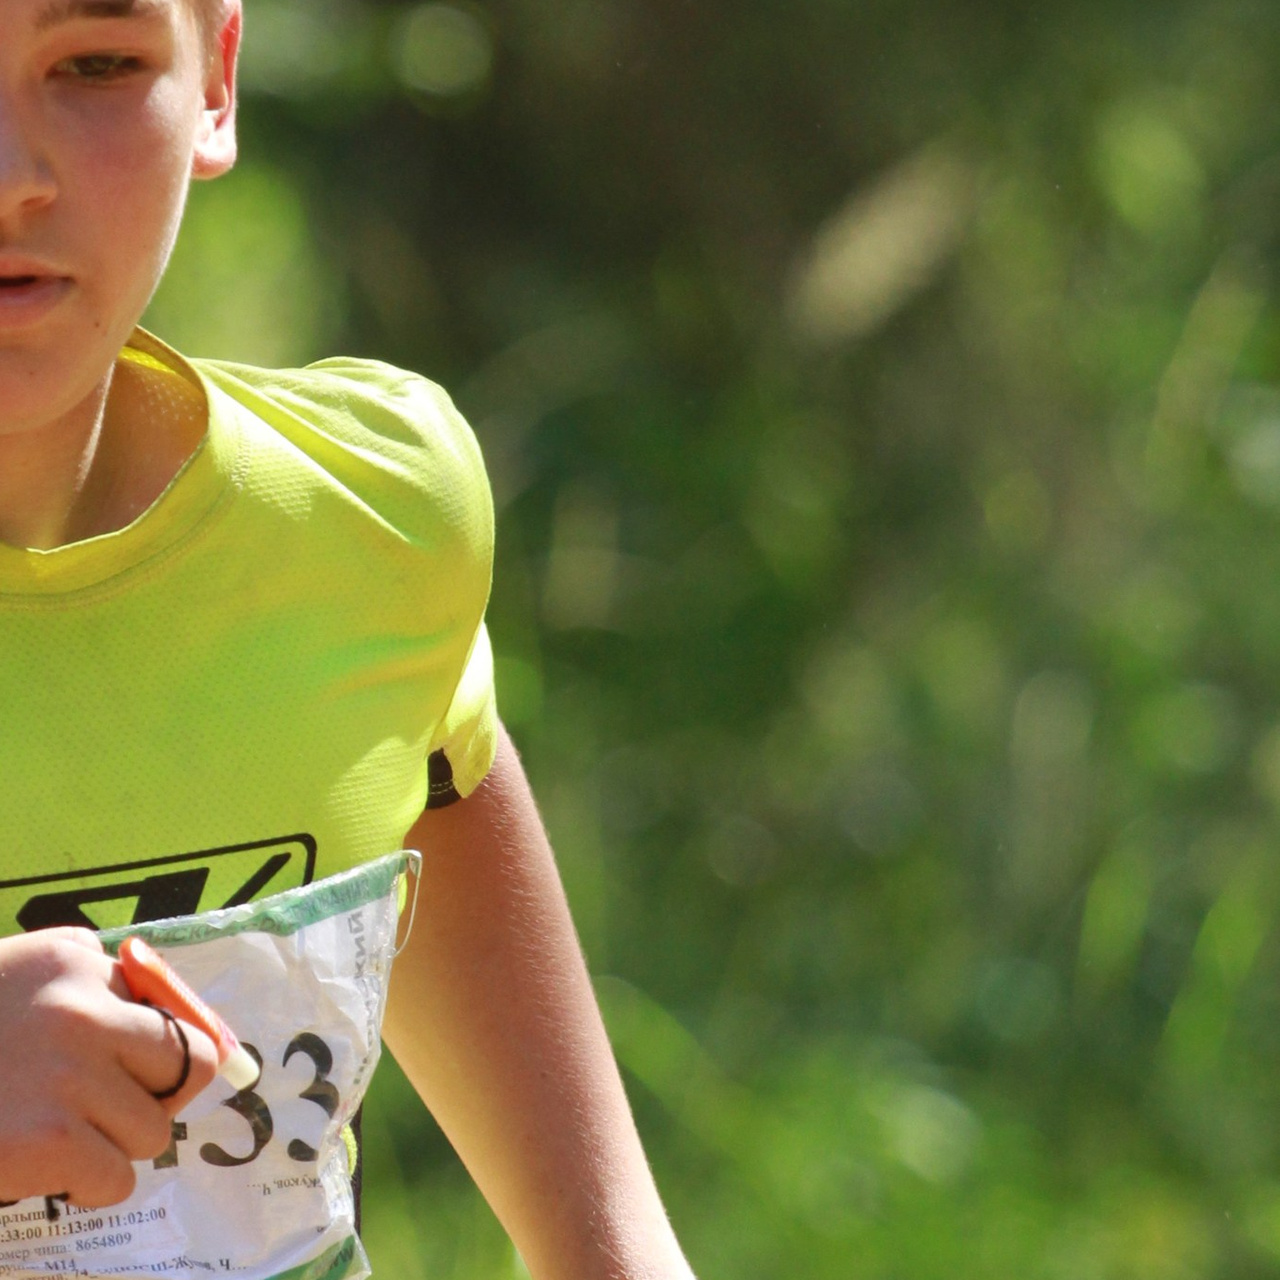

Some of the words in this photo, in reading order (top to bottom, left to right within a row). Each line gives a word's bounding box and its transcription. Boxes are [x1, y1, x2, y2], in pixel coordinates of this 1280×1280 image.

[154, 1032, 340, 1170] 33
[47, 1217, 104, 1238] 11:13:00
[107, 1206, 167, 1227] 11:02:00
[74, 1231, 133, 1253] 8654809
